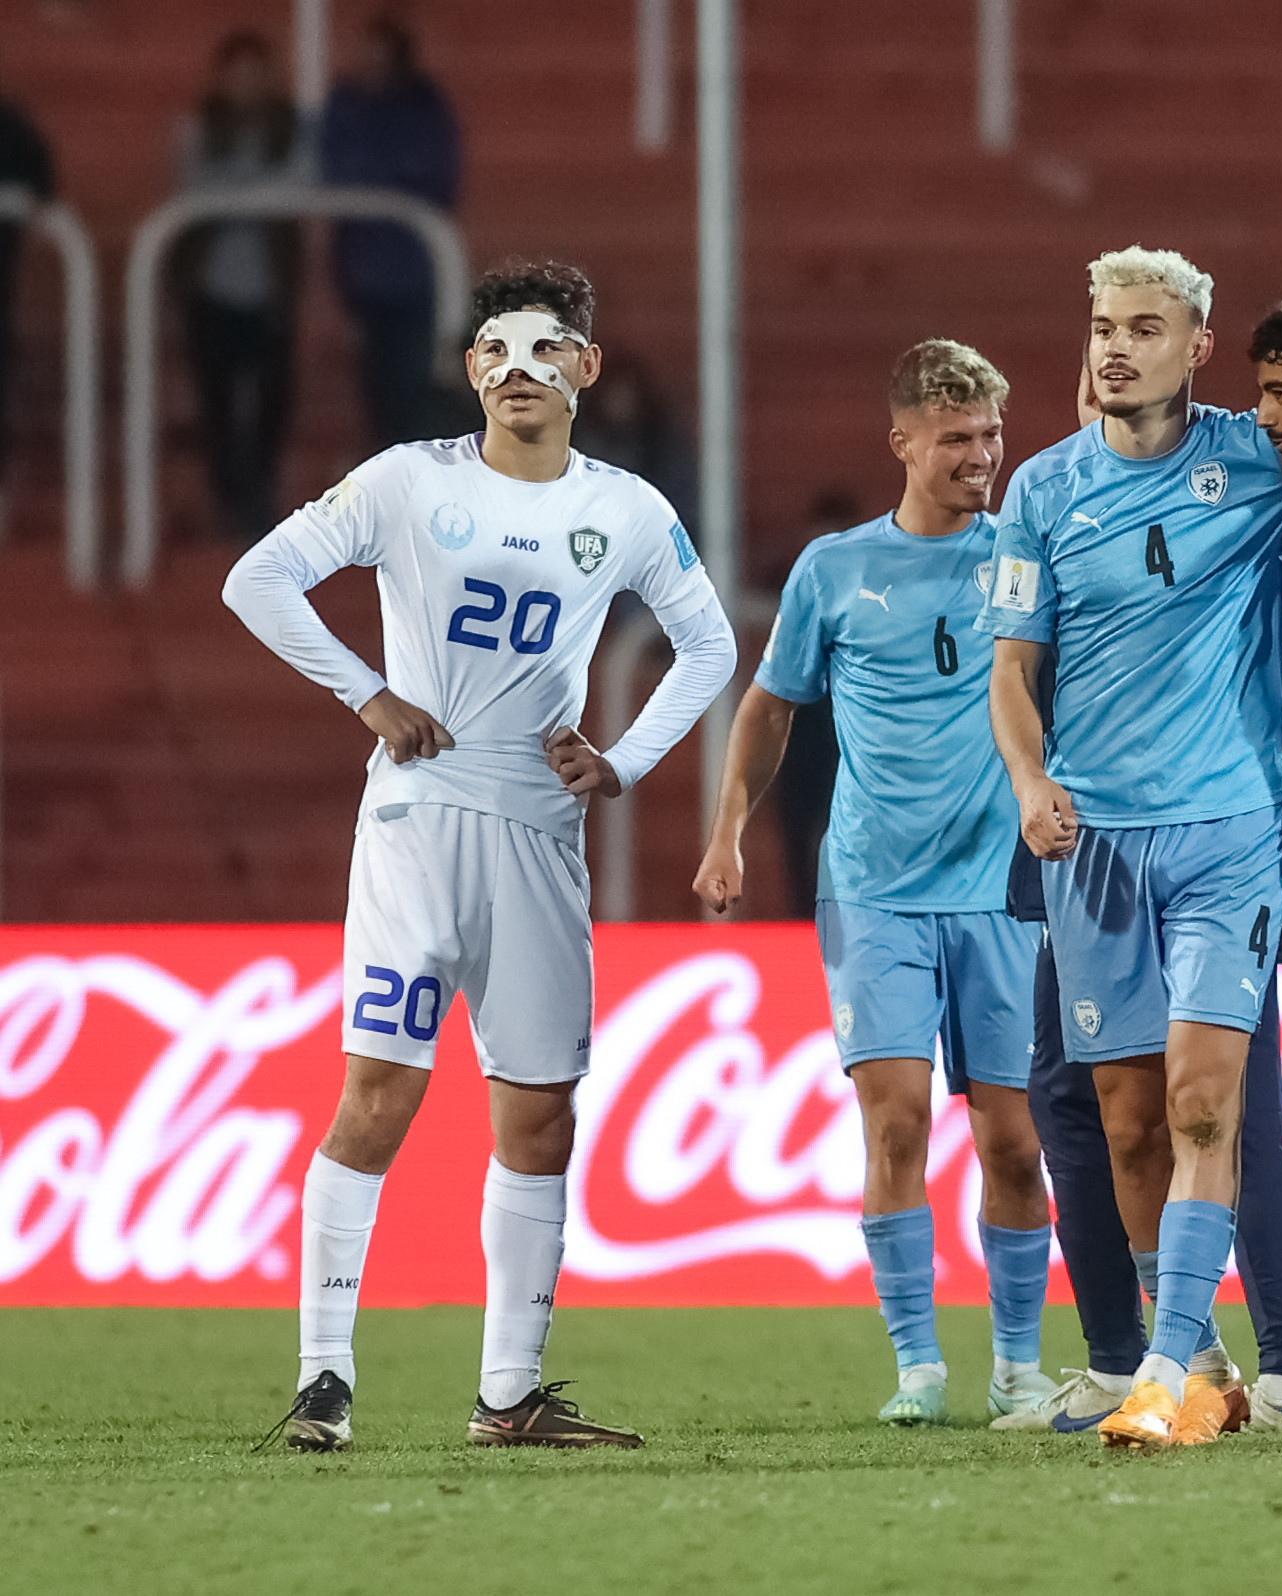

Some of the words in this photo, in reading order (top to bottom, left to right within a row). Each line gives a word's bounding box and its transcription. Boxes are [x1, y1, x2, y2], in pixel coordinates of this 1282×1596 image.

[501, 534, 540, 552] JAKO
[573, 534, 604, 555] UFA
[1145, 524, 1175, 587] 4
[446, 576, 562, 655] 20
[933, 616, 959, 677] 6
[1248, 904, 1271, 970] 4
[352, 964, 442, 1042] 20
